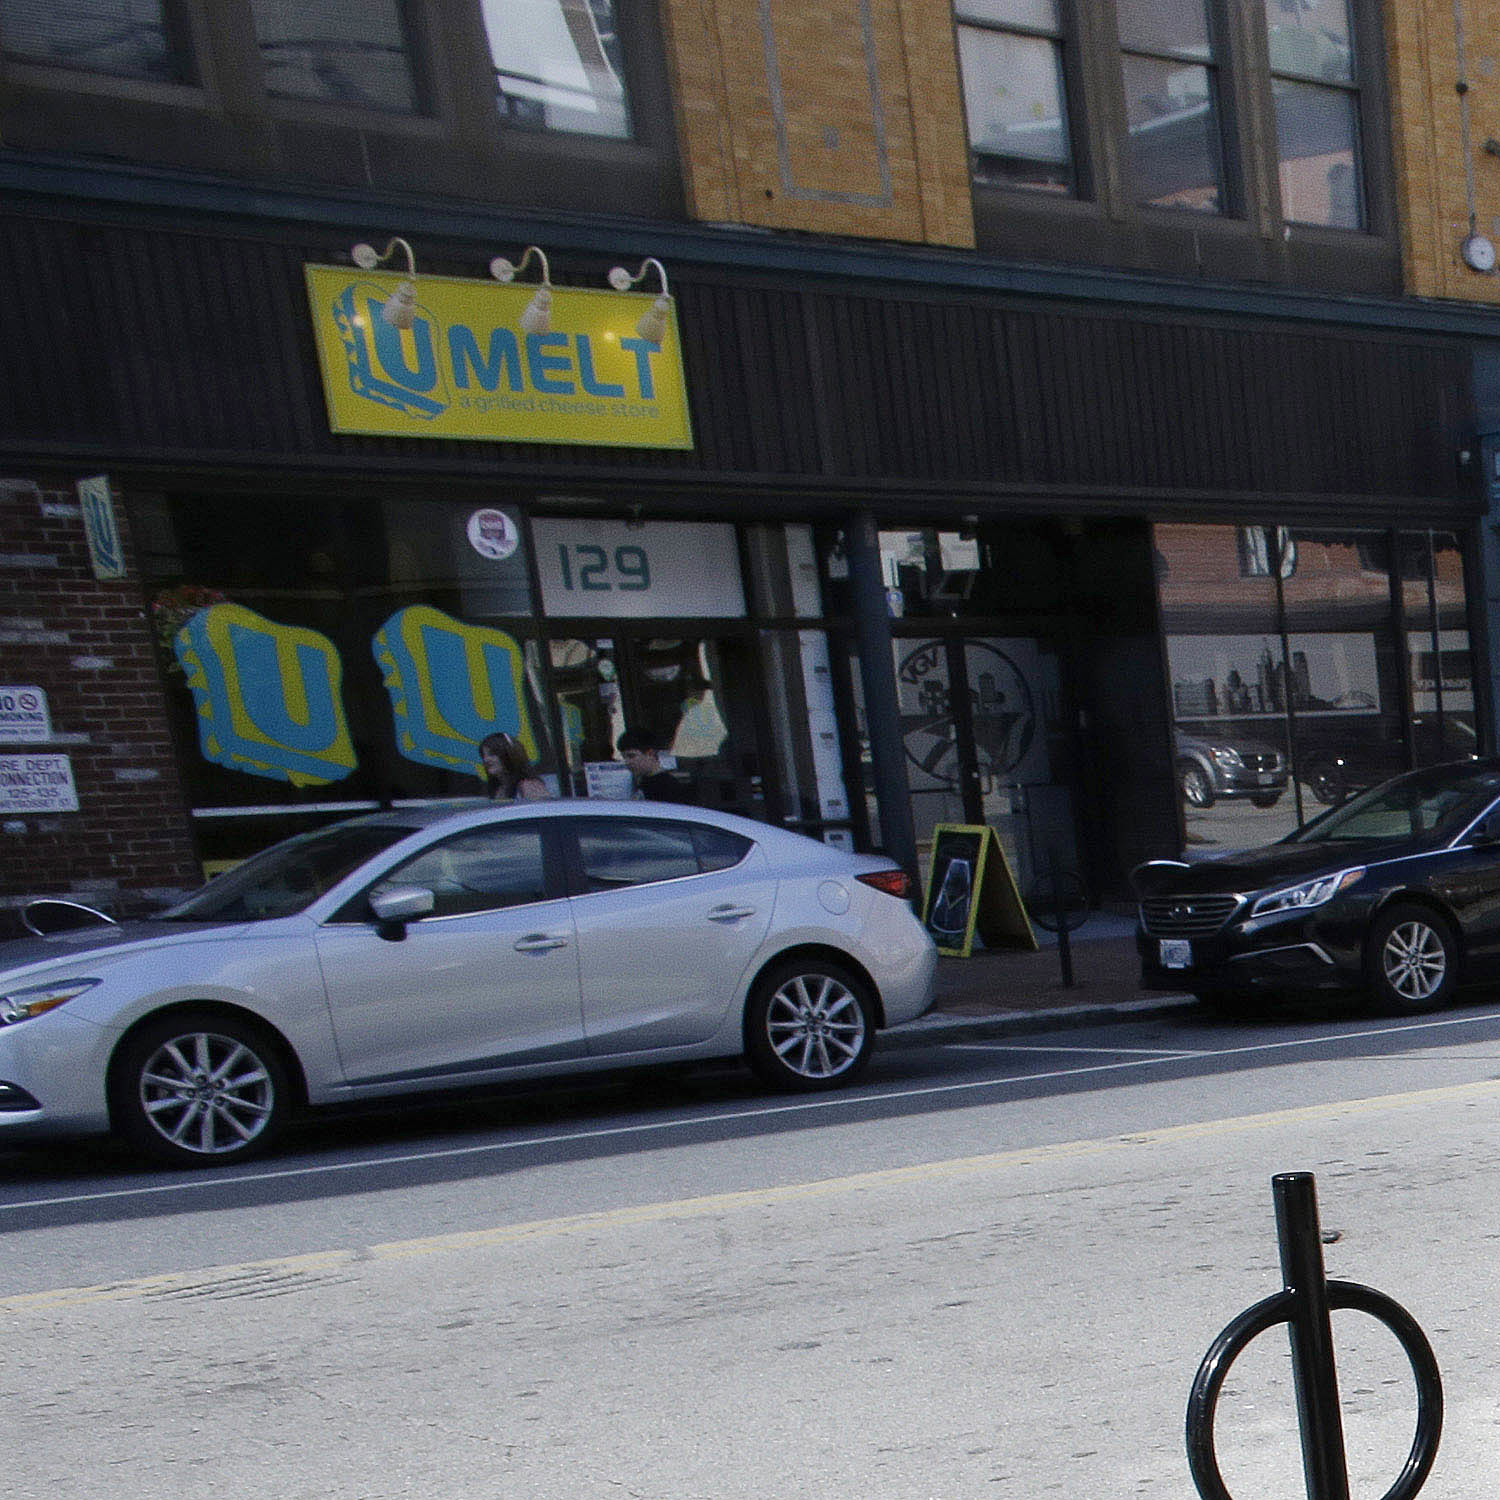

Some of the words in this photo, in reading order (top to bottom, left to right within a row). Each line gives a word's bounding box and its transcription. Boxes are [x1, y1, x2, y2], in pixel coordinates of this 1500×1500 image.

[447, 324, 662, 400] MELT
[475, 393, 537, 413] grilled
[539, 397, 608, 416] cheese
[611, 401, 660, 418] store
[557, 543, 651, 591] 129
[0, 712, 44, 722] MOKING
[0, 772, 68, 786] ONNECTION
